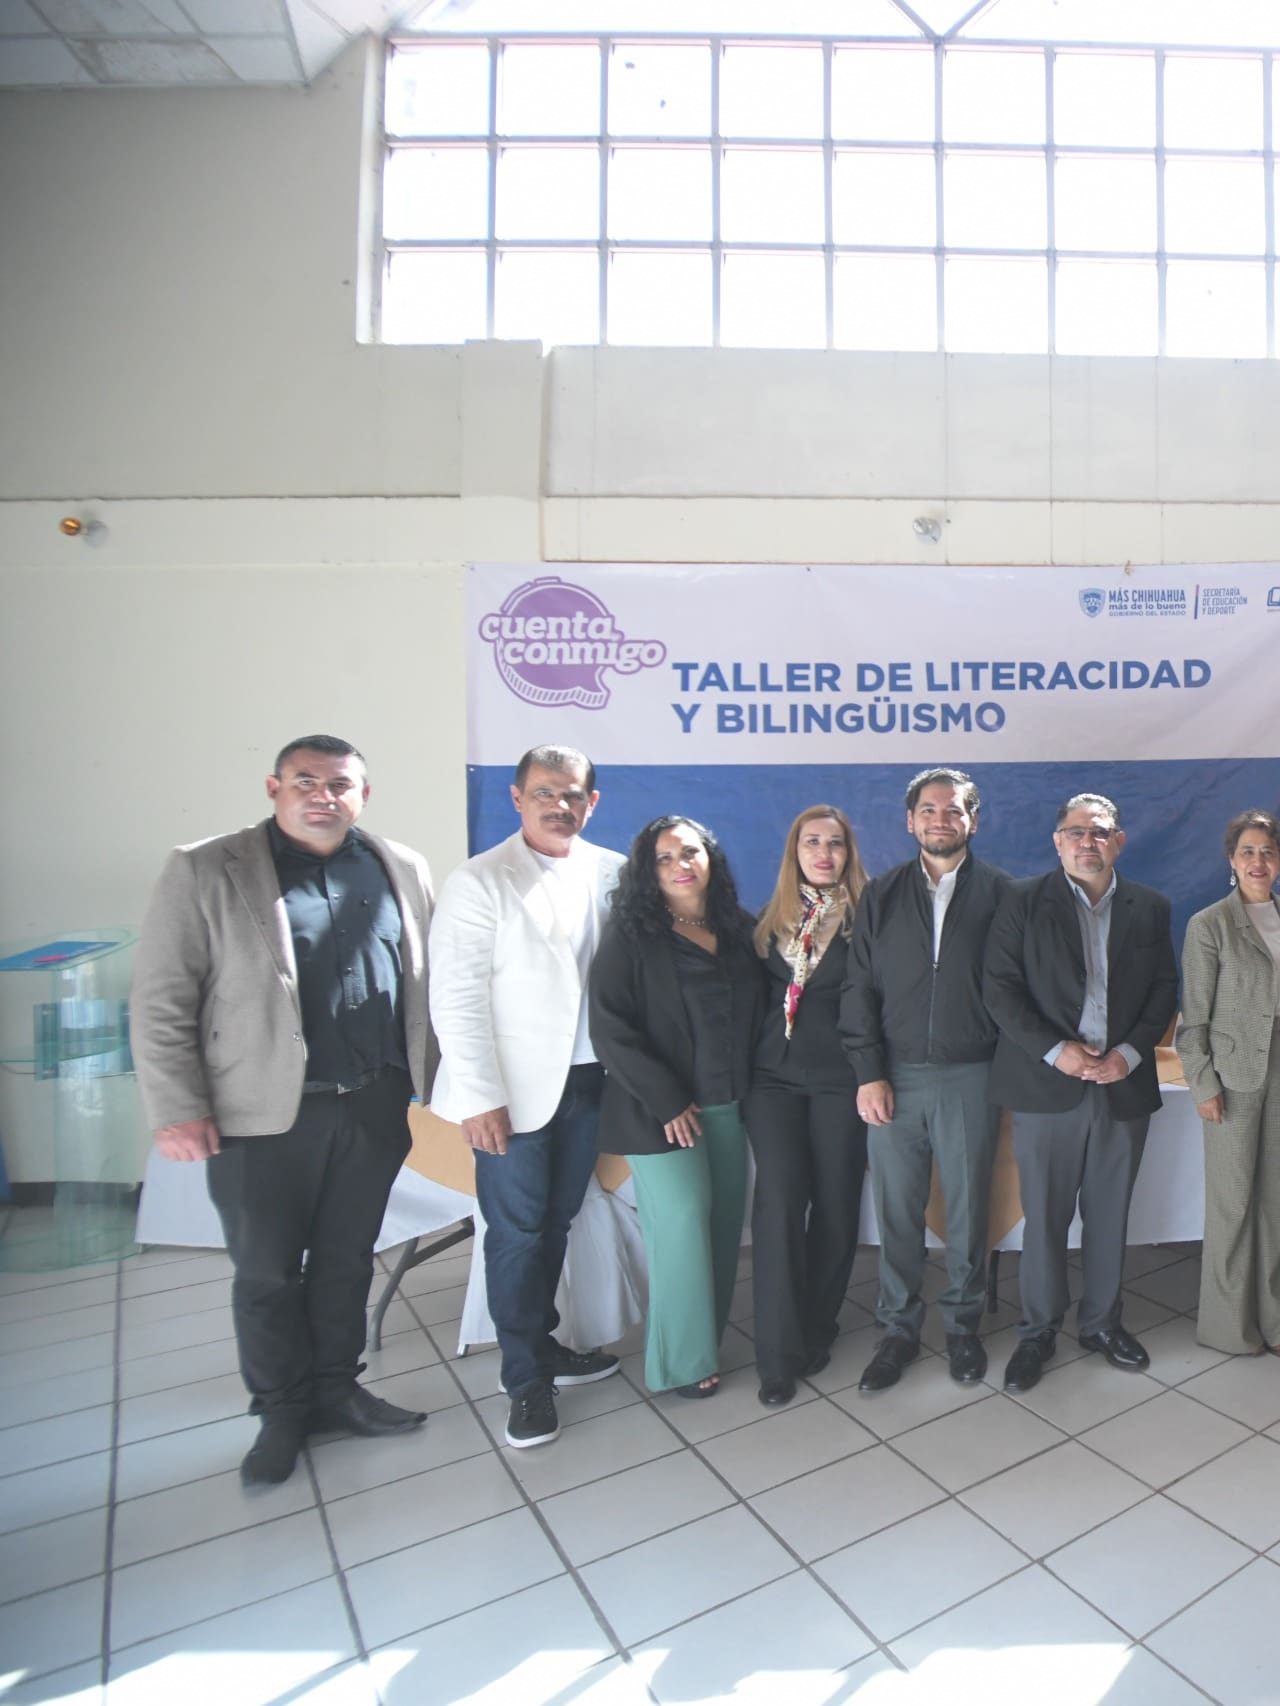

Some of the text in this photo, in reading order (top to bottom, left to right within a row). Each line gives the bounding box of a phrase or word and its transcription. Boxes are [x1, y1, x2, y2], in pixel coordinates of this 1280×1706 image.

[1108, 587, 1186, 602] MÁS CHIHUAHUA
[1202, 587, 1240, 597] SECRETARÍA
[1108, 602, 1186, 610] más de lo bueno
[1202, 595, 1248, 606] DE EDUCACIÓN
[1207, 606, 1236, 615] DEPORTE
[481, 611, 614, 640] cuenta
[503, 634, 665, 673] conmigo
[672, 659, 1212, 692] TALLER DE LITERACIDAD
[671, 696, 1005, 733] Y BILINGÜISMO
